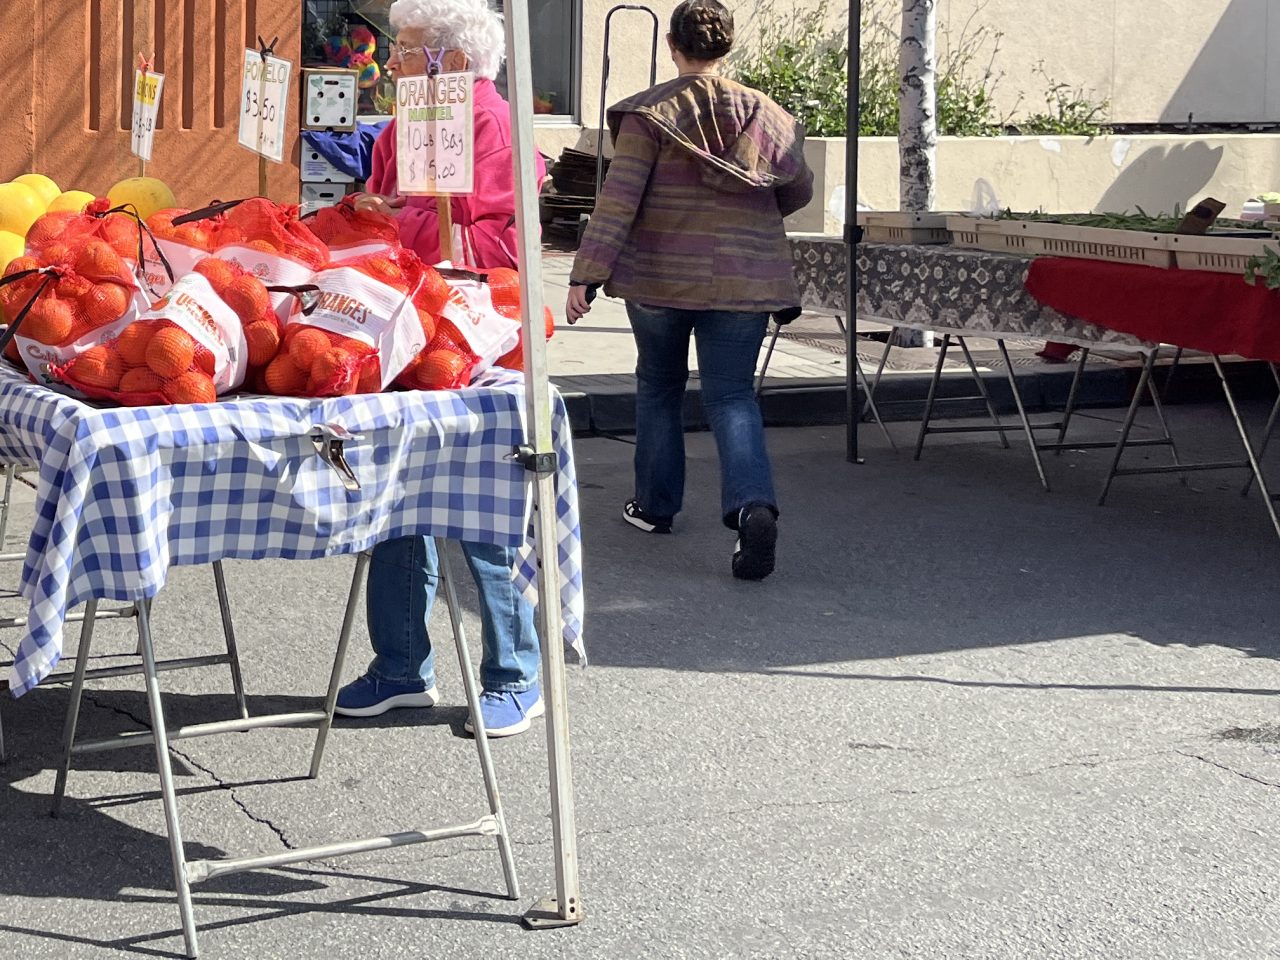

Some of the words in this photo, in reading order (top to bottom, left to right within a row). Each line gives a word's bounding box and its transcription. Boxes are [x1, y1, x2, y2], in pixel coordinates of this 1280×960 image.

[399, 76, 467, 107] ORANGES
[407, 106, 454, 122] NAVEL
[441, 127, 464, 156] Bag
